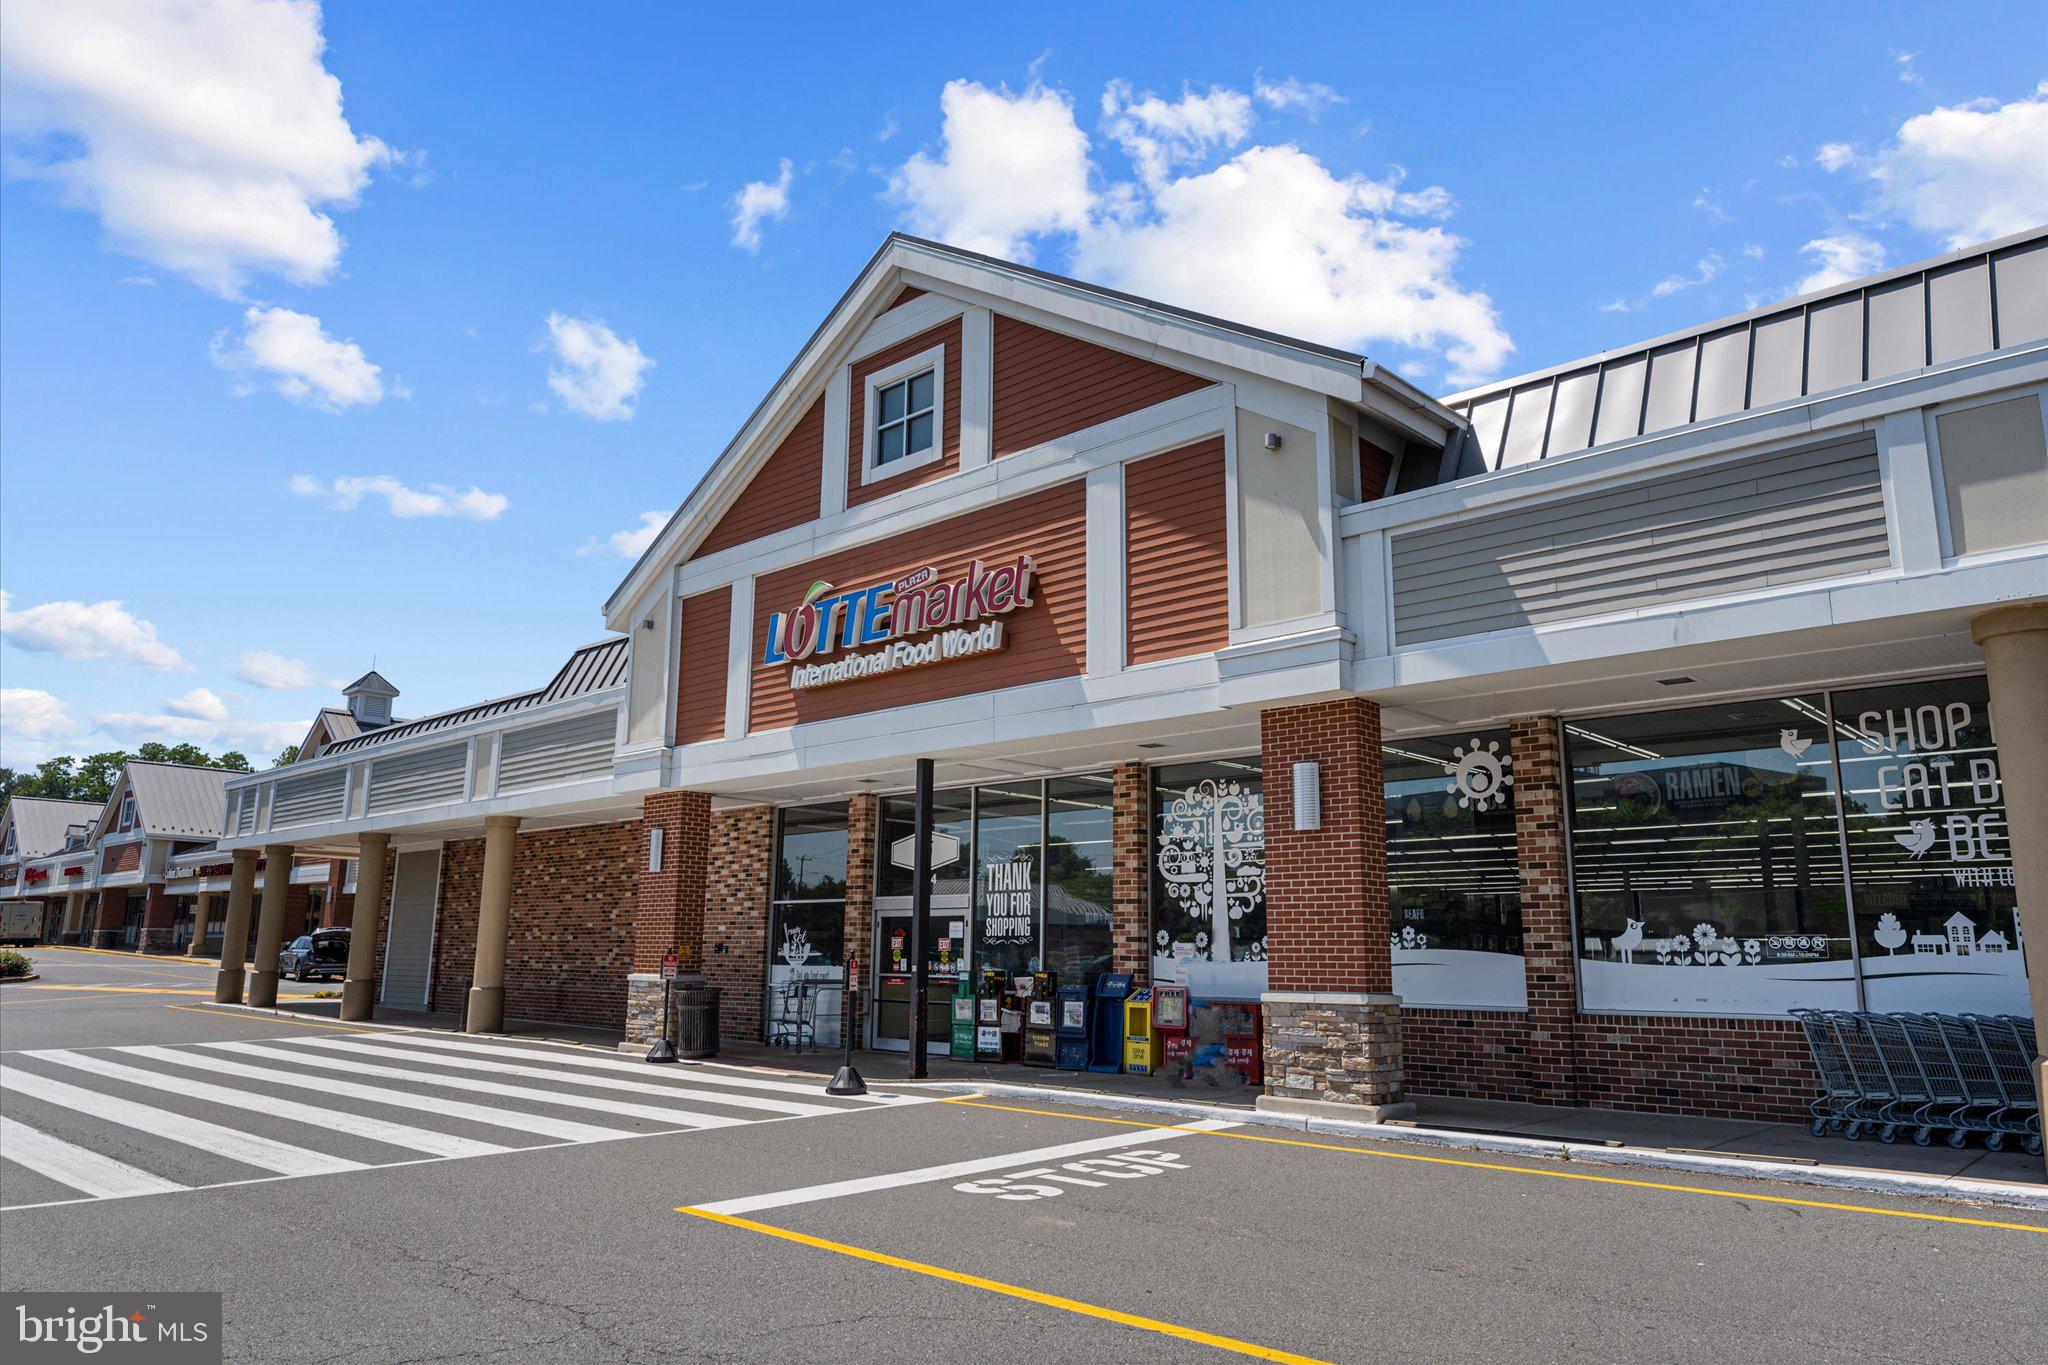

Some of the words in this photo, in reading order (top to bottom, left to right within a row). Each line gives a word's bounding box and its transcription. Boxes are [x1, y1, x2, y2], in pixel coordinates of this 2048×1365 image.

[898, 570, 928, 592] PLAZA
[764, 582, 894, 665] LOTTE
[890, 555, 1036, 636] market
[790, 645, 893, 690] International
[892, 633, 942, 669] Food
[942, 620, 1003, 658] World
[1858, 702, 1972, 755] SHOP
[1665, 766, 1741, 801] RAMEN
[1877, 760, 1955, 810] EAT
[986, 862, 1032, 891] THANK
[986, 893, 1007, 917] YOU
[1010, 892, 1031, 916] FOR
[986, 917, 1031, 937] SHOPPING
[1132, 1047, 1145, 1055] take
[952, 1150, 1191, 1201] STOP
